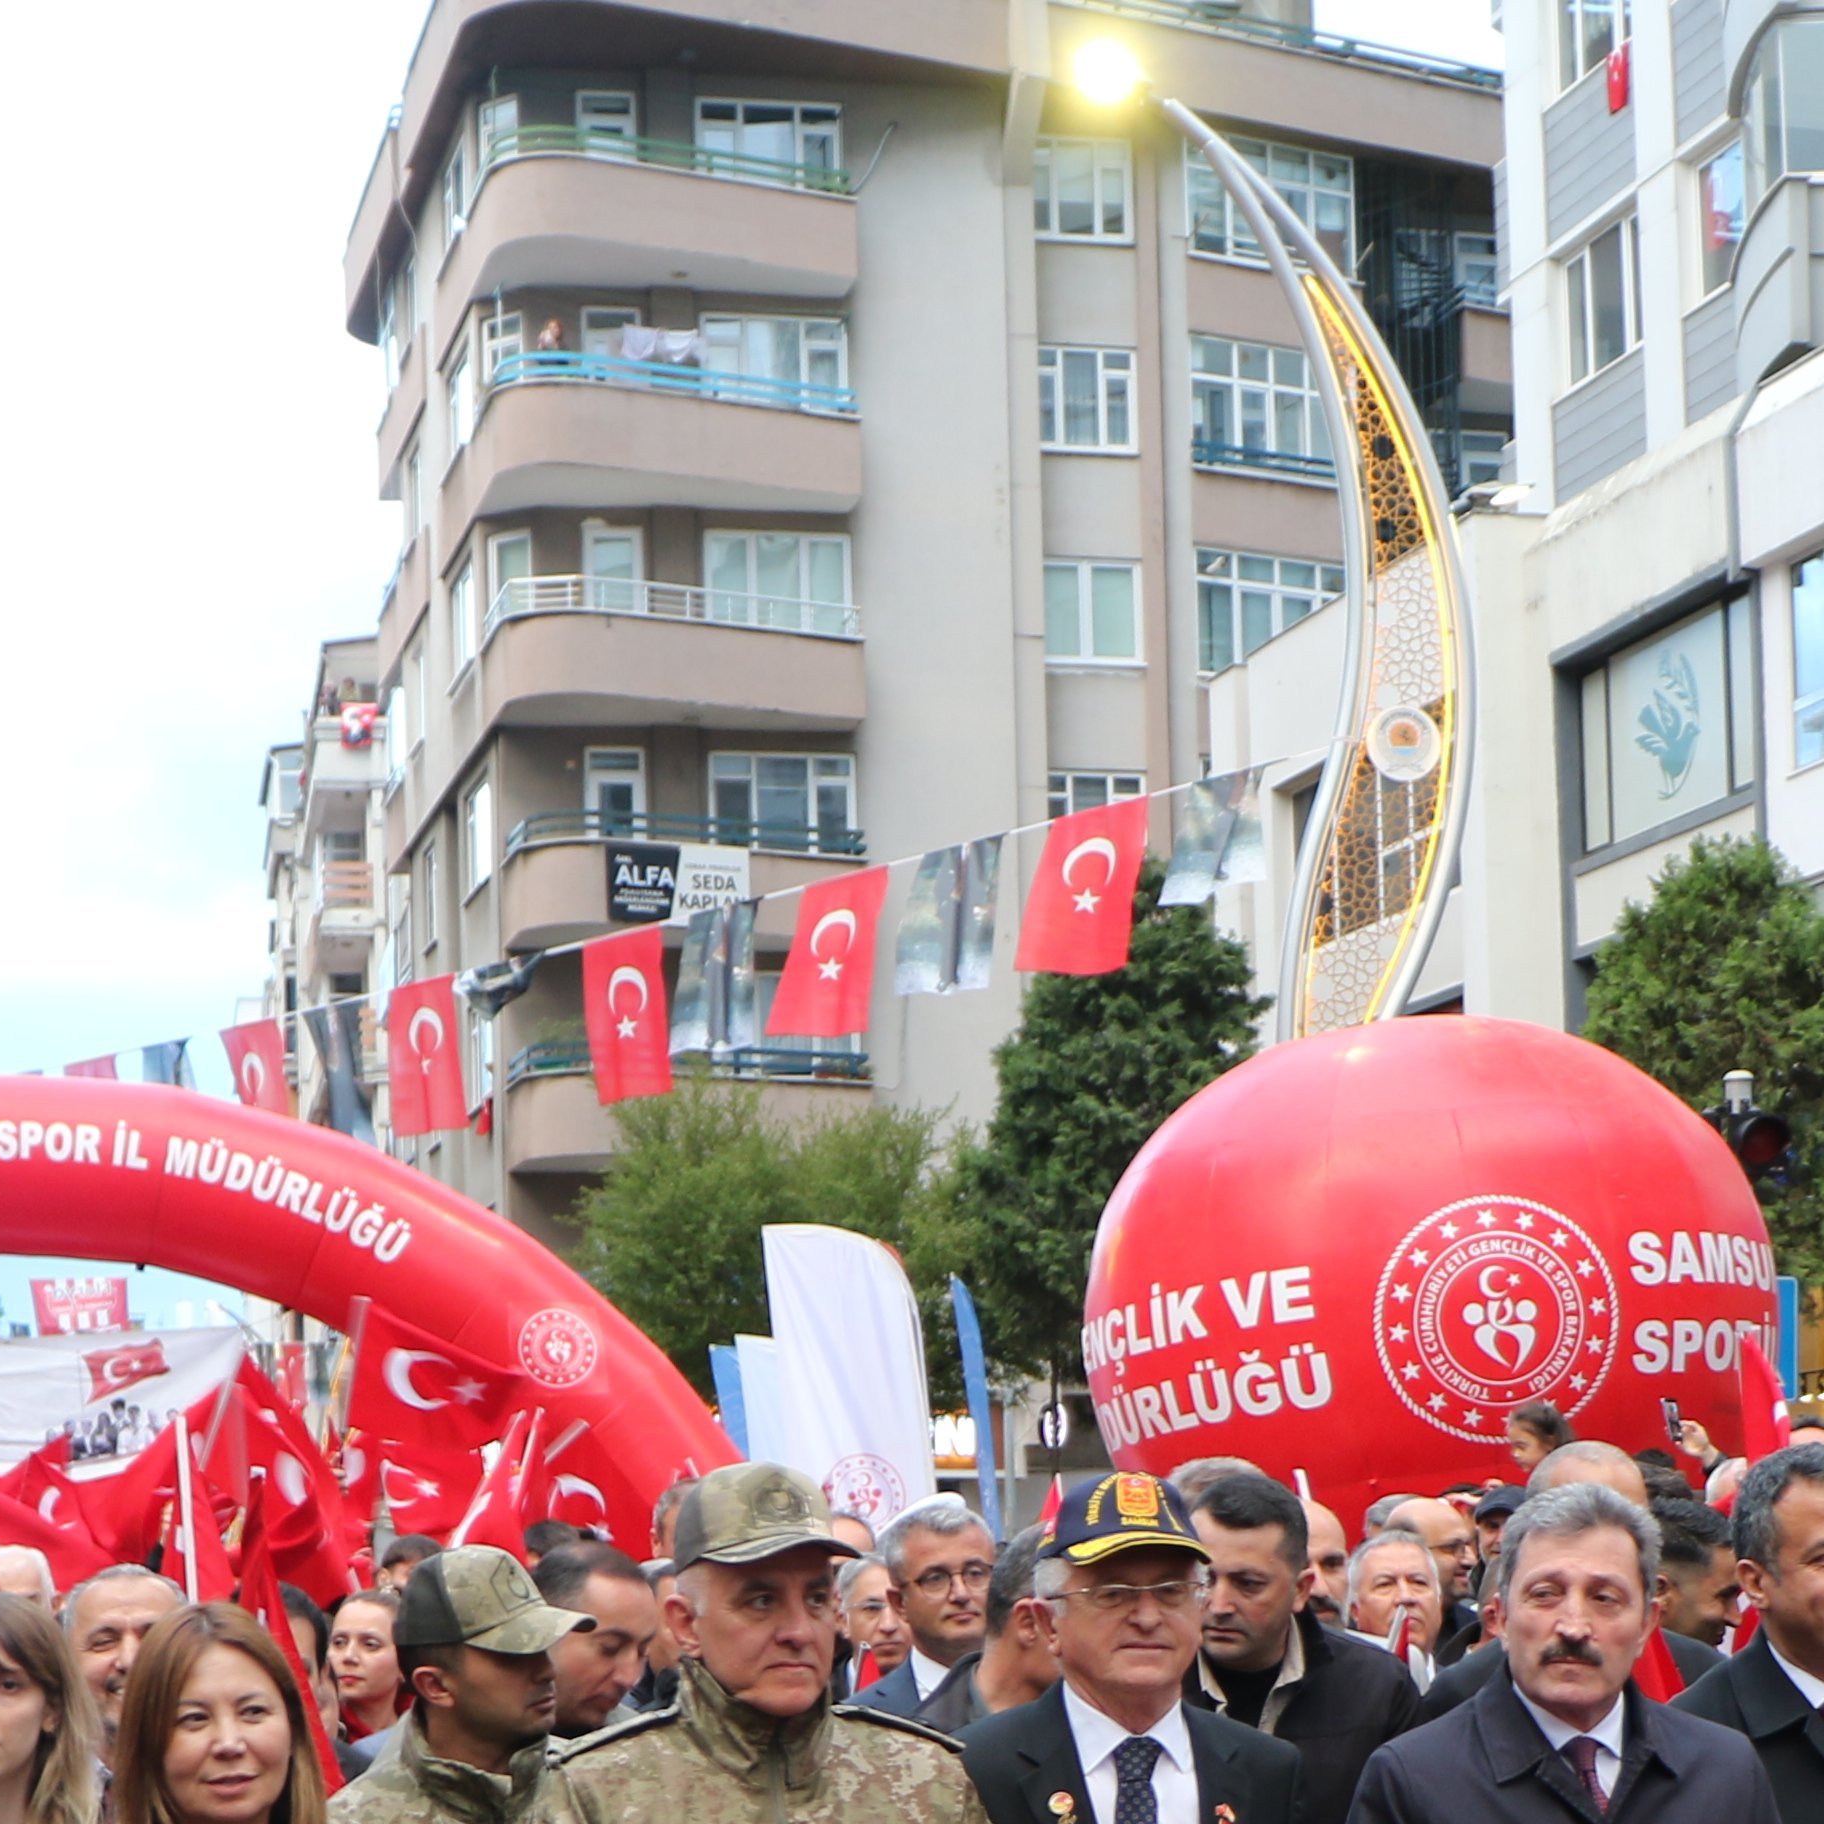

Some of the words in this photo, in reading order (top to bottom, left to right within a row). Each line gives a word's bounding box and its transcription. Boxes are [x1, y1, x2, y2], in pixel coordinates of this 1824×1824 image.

[614, 864, 675, 888] ALFA
[691, 874, 737, 890] SEDA
[111, 1118, 150, 1171] İL
[163, 1135, 413, 1263] MÜDÜRLÜĞÜ
[1468, 1238, 1537, 1260] GENÇLİK
[1536, 1251, 1560, 1273] VE
[1219, 1265, 1316, 1330] VE
[1420, 1246, 1469, 1353] CUMHURİYETİ
[1551, 1269, 1578, 1313] SPOR
[1429, 1351, 1491, 1401] TÜRKİYE
[1528, 1314, 1579, 1392] BAKANLIĞI
